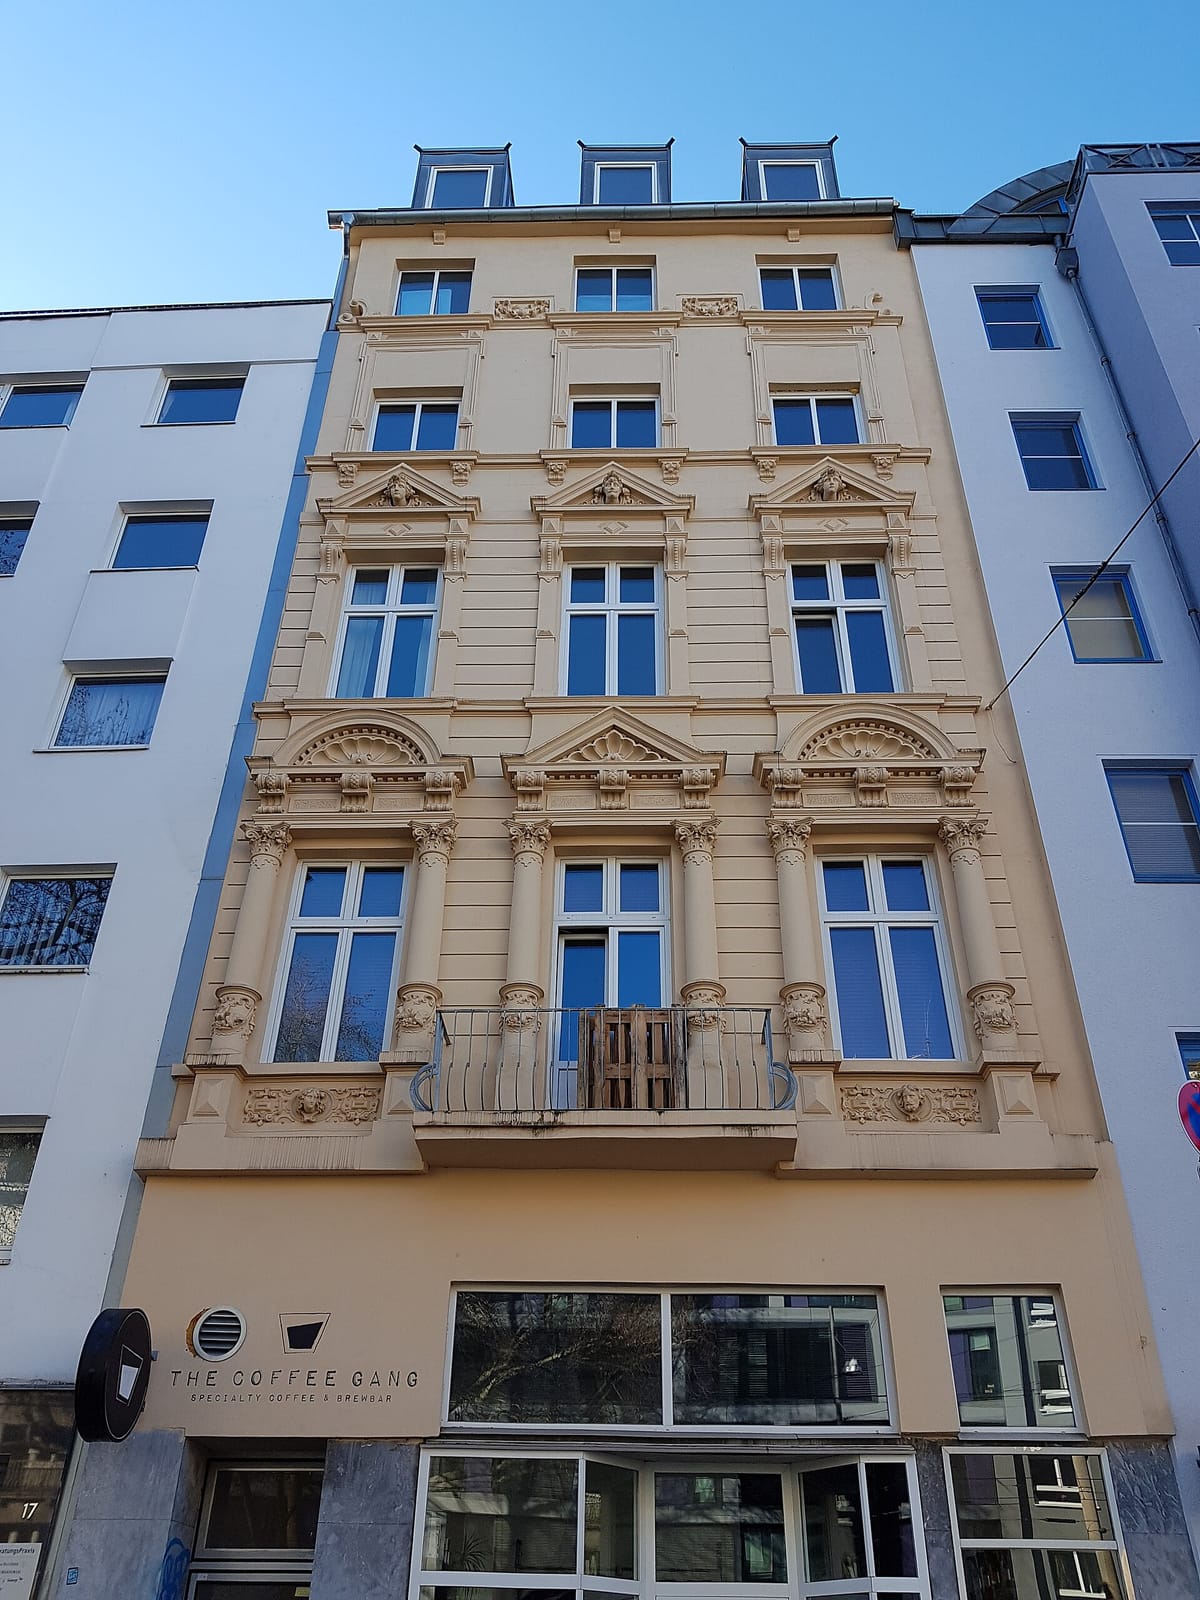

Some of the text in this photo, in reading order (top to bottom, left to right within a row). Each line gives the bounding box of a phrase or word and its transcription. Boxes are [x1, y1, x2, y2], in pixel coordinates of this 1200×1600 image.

[171, 1370, 418, 1387] THE COFFEE GANG
[190, 1394, 392, 1402] SPECIALTY COFFEE & BREWBAR
[21, 1502, 39, 1519] 17
